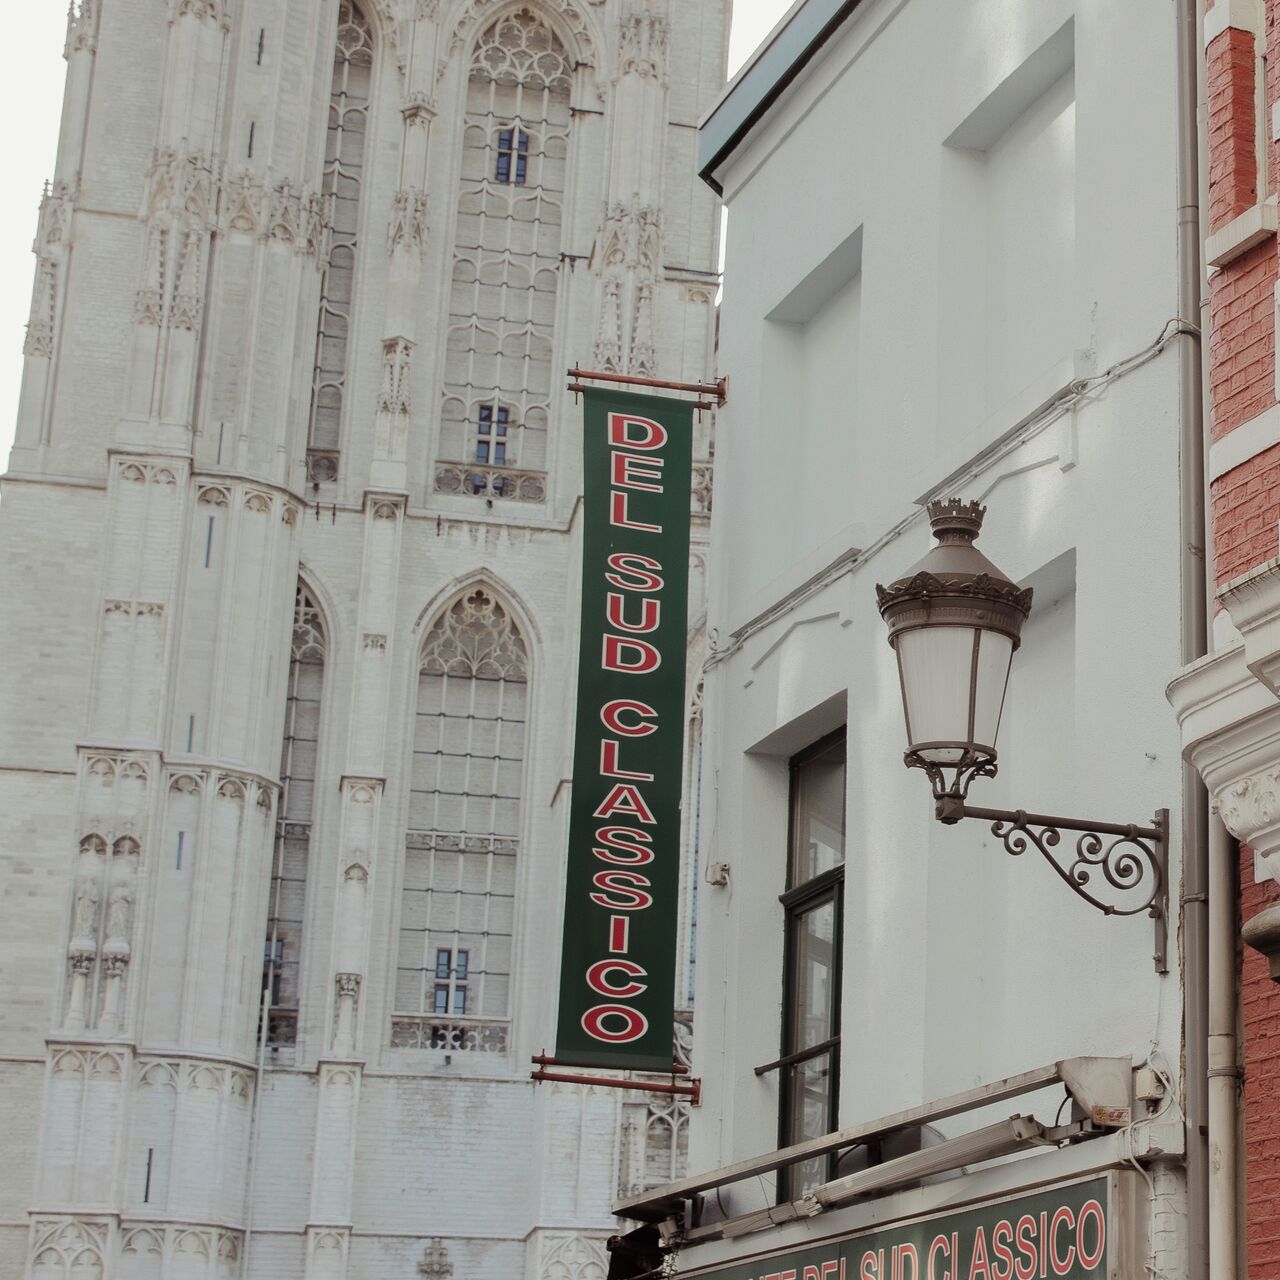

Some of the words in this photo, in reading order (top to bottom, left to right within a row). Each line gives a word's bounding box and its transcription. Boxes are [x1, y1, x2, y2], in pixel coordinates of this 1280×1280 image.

[605, 410, 669, 534] DEL
[601, 552, 665, 676] SUD
[580, 697, 659, 1045] CLASSICO
